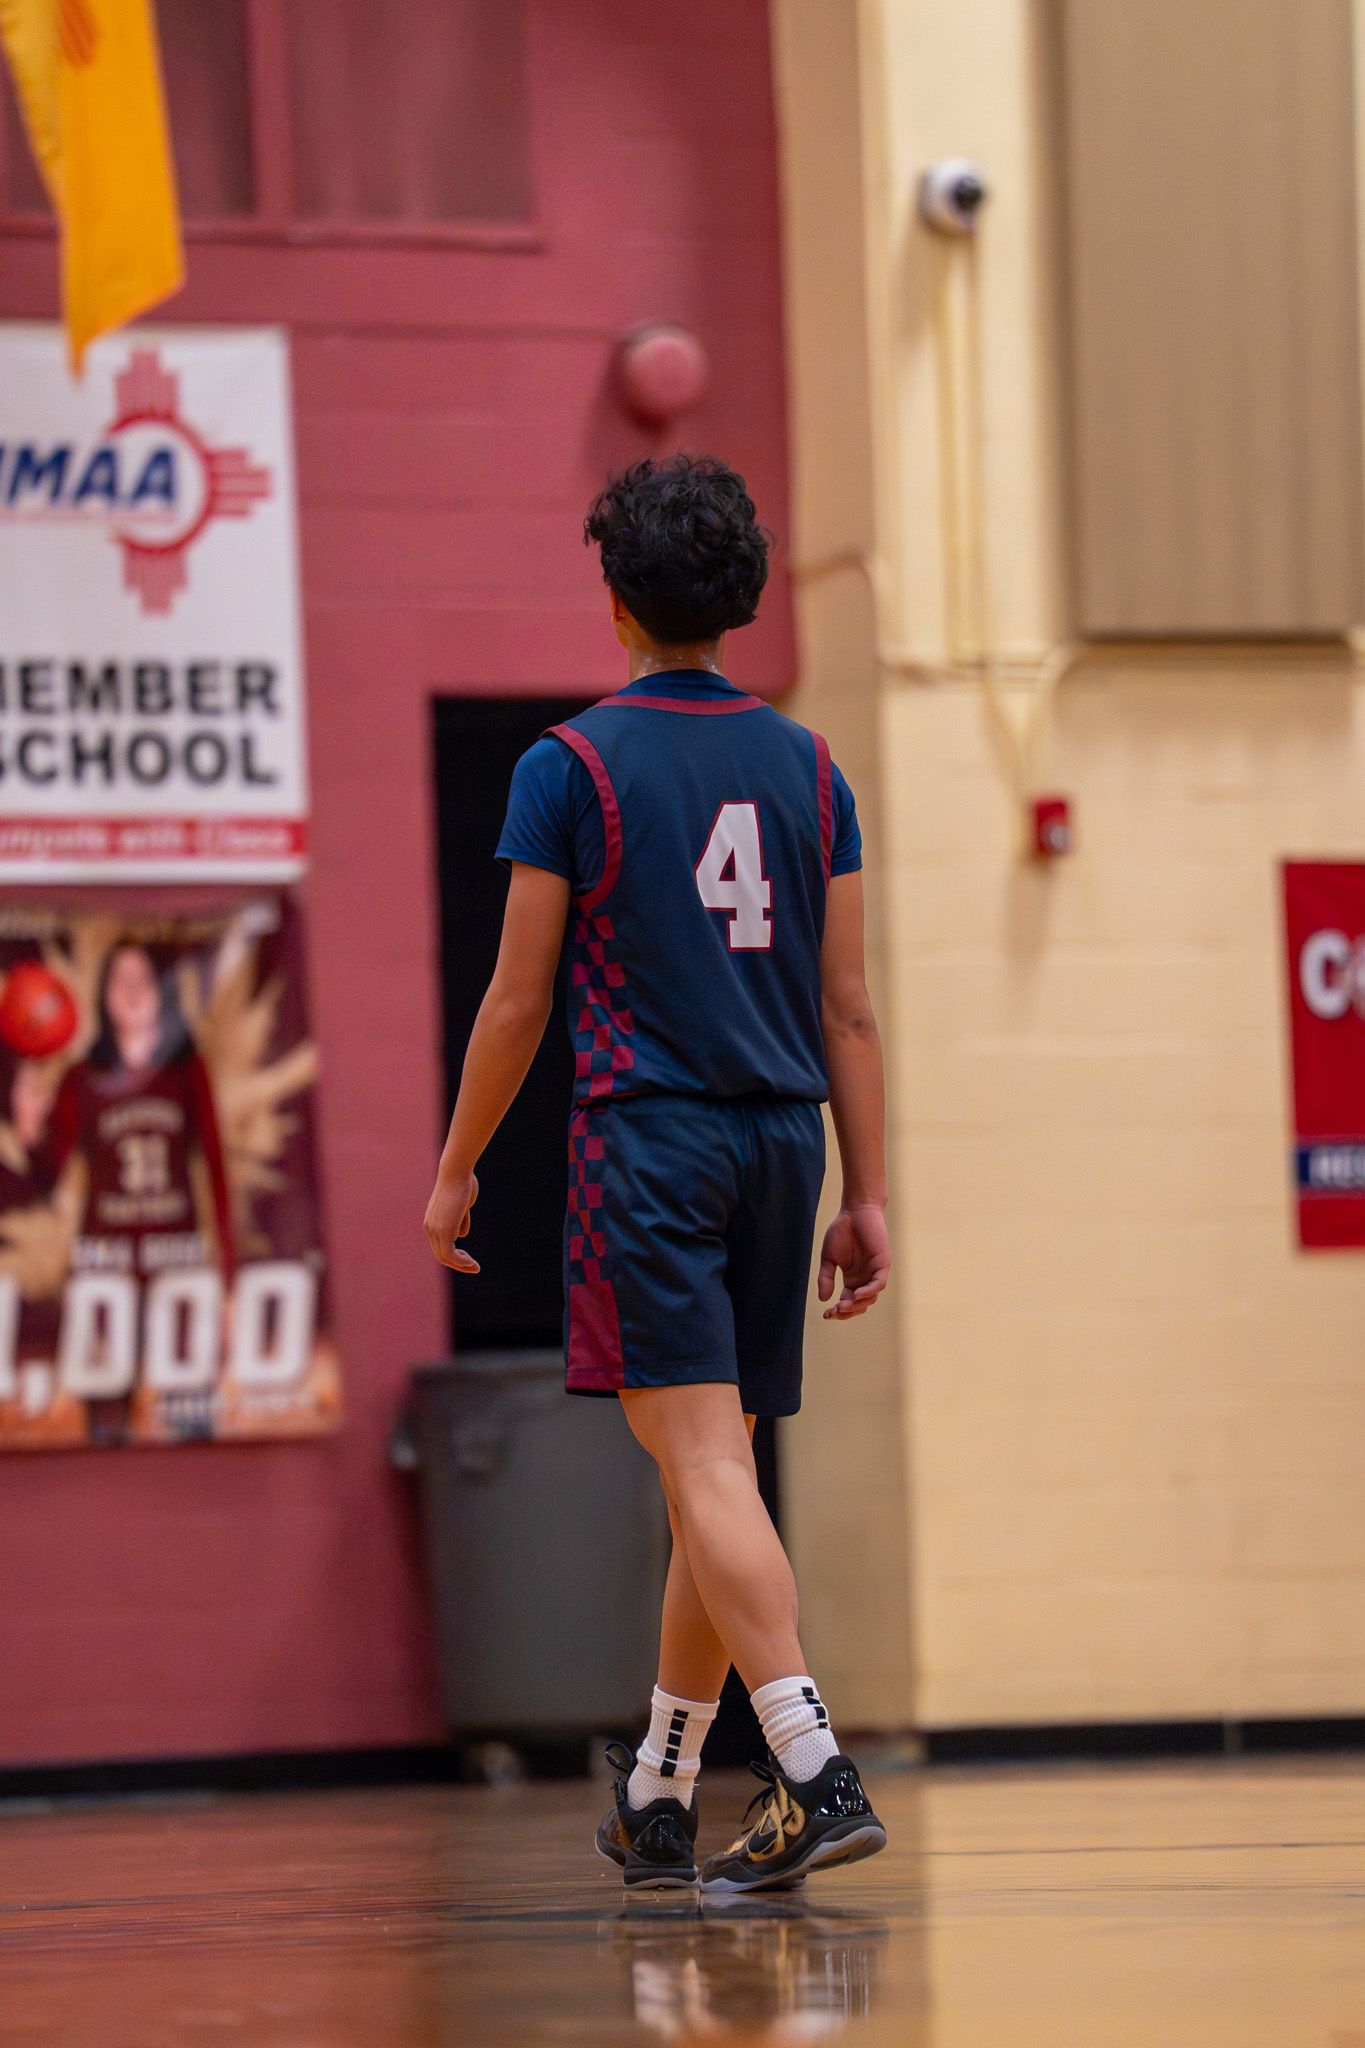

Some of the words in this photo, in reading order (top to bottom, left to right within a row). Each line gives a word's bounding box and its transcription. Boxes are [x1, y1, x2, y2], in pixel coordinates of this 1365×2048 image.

[0, 445, 177, 505] MAA
[0, 661, 279, 716] EMBER
[0, 729, 277, 786] CHOOL
[694, 799, 773, 952] 4
[1299, 928, 1365, 1020] C
